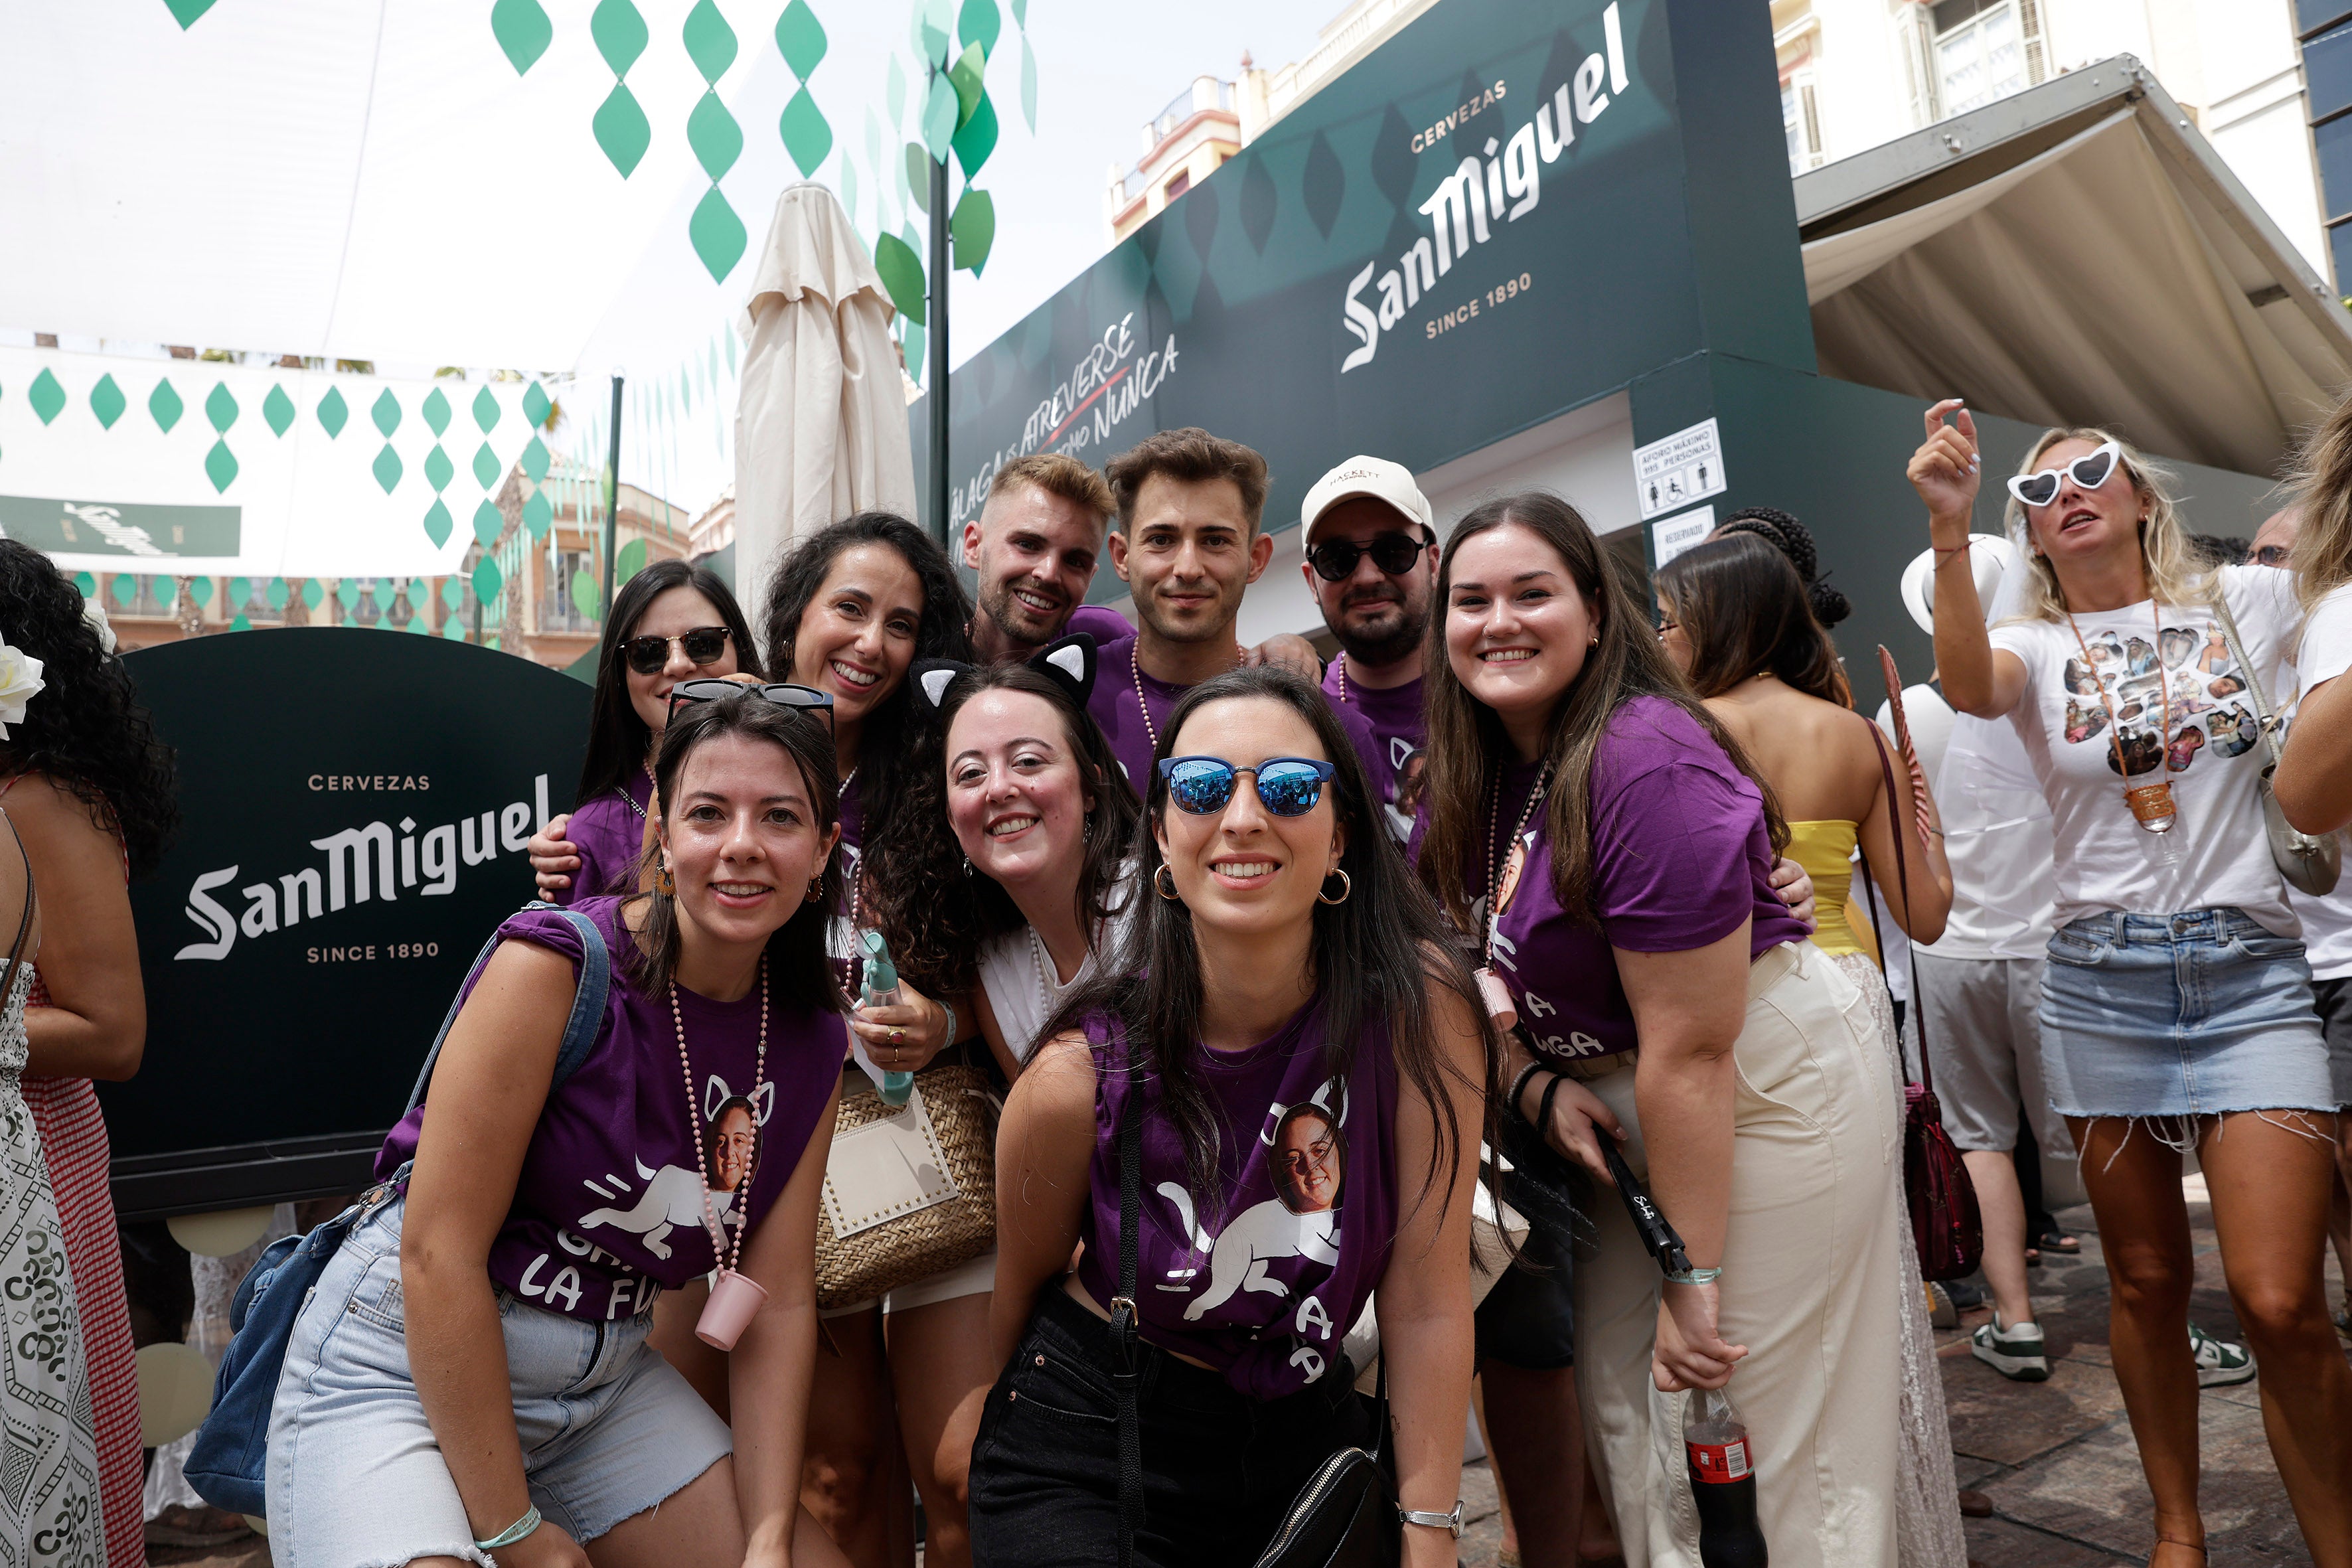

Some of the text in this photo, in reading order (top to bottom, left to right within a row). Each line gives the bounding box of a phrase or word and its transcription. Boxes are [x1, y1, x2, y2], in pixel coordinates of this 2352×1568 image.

[1411, 80, 1507, 154] CERVEZAS
[1425, 273, 1531, 339] SINCE 1890
[1094, 333, 1179, 445] NUNCA
[1330, 469, 1380, 486] HACKETT
[307, 774, 430, 791] CERVEZAS
[307, 942, 439, 963] SINCE 1890
[520, 1253, 583, 1312] LA
